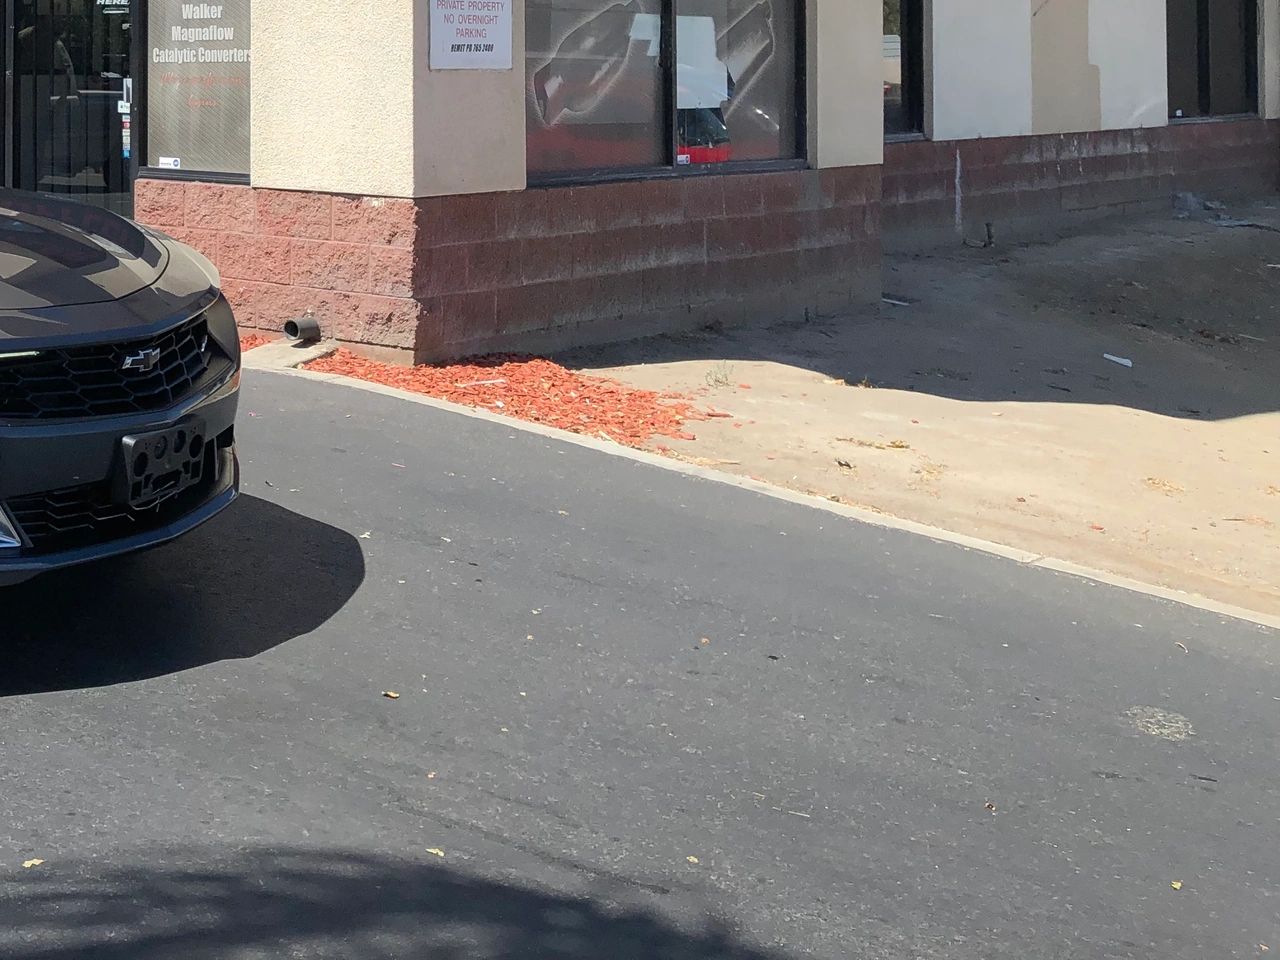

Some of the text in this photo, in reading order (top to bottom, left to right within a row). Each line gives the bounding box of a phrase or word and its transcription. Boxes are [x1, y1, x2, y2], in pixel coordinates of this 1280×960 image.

[182, 3, 223, 19] Walker
[436, 0, 505, 12] PRIVATE PROPERTY
[444, 14, 499, 25] NO OVERNIGHT
[171, 25, 234, 42] Magnaflow
[456, 28, 487, 38] PARKING
[152, 47, 196, 64] Catalytic
